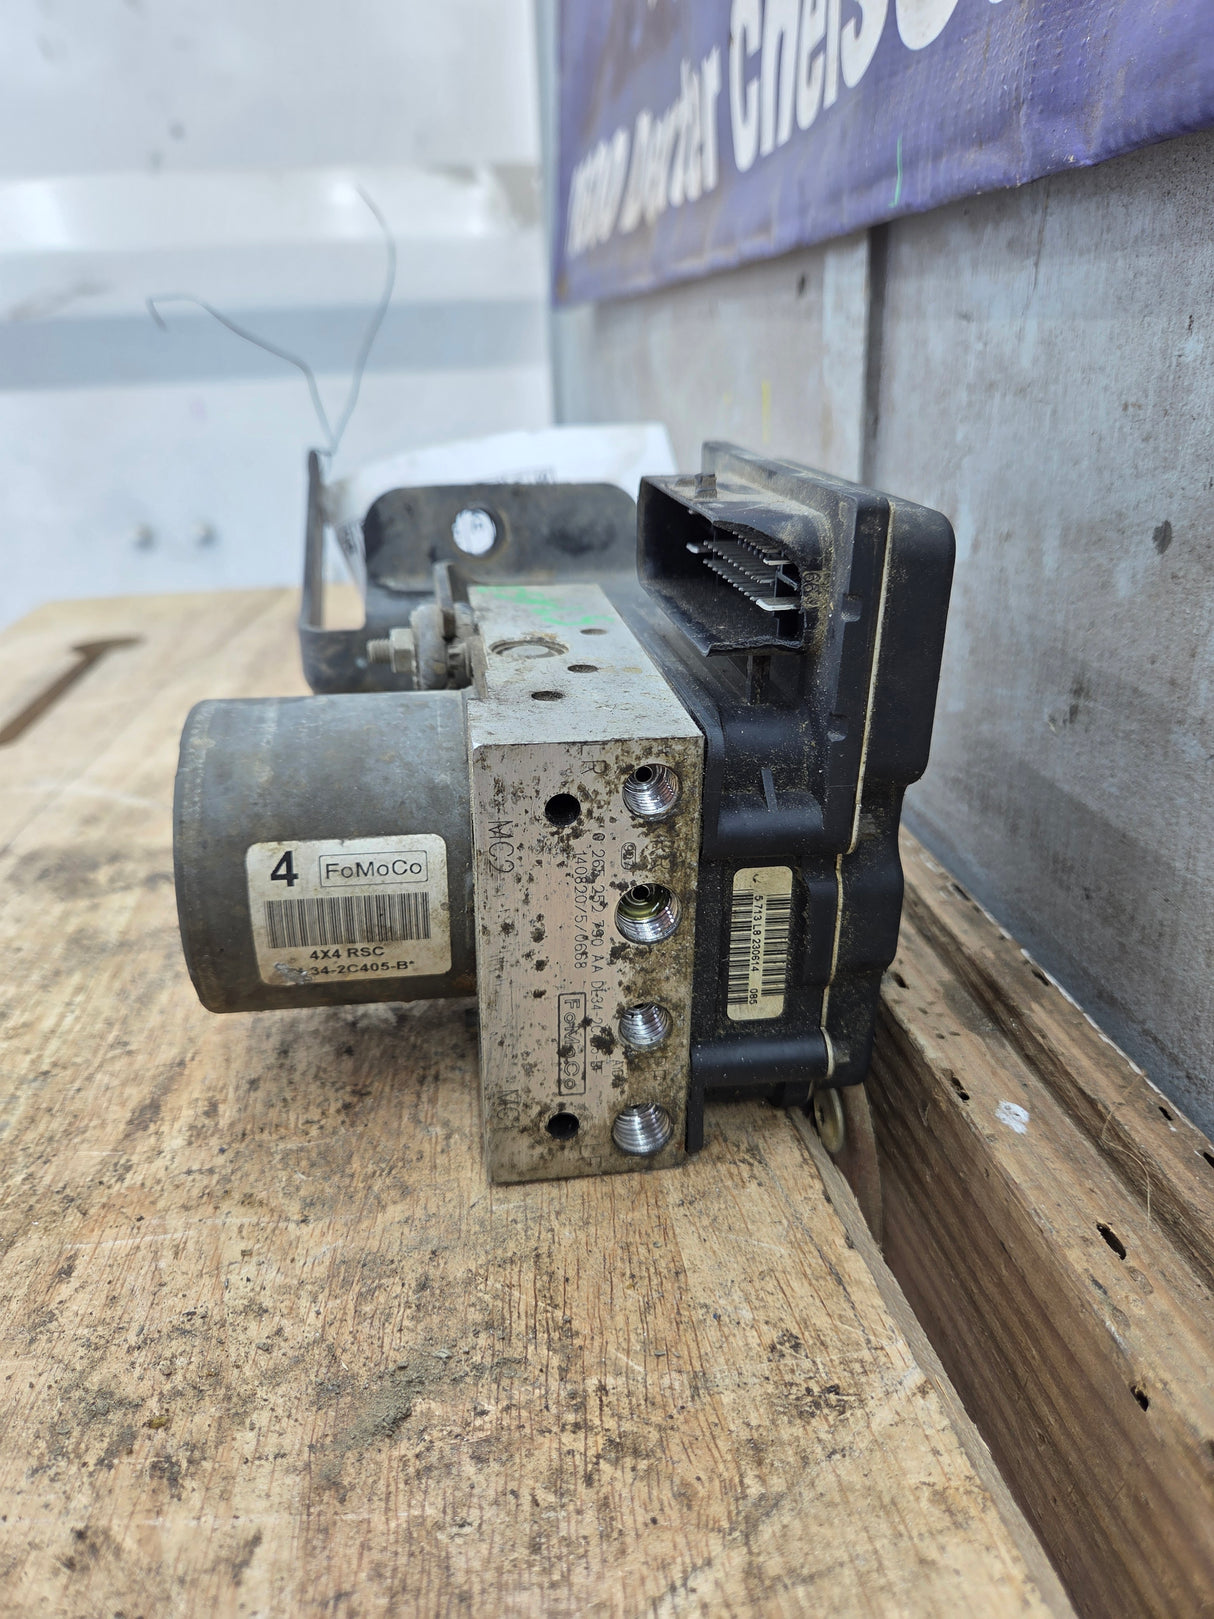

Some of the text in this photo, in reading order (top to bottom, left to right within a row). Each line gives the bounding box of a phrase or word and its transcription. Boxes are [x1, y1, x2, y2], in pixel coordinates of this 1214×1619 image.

[488, 820, 515, 873] MC2
[270, 850, 299, 887] 4
[325, 859, 422, 880] FoMoCo
[591, 885, 606, 913] 252
[753, 904, 763, 921] 713
[590, 920, 605, 946] 790
[752, 923, 762, 935] L8
[309, 946, 385, 960] 4X4 RSC
[590, 954, 604, 973] AA
[751, 938, 761, 972] 230614
[749, 988, 758, 1005] 085
[563, 998, 581, 1090] FoMoCo
